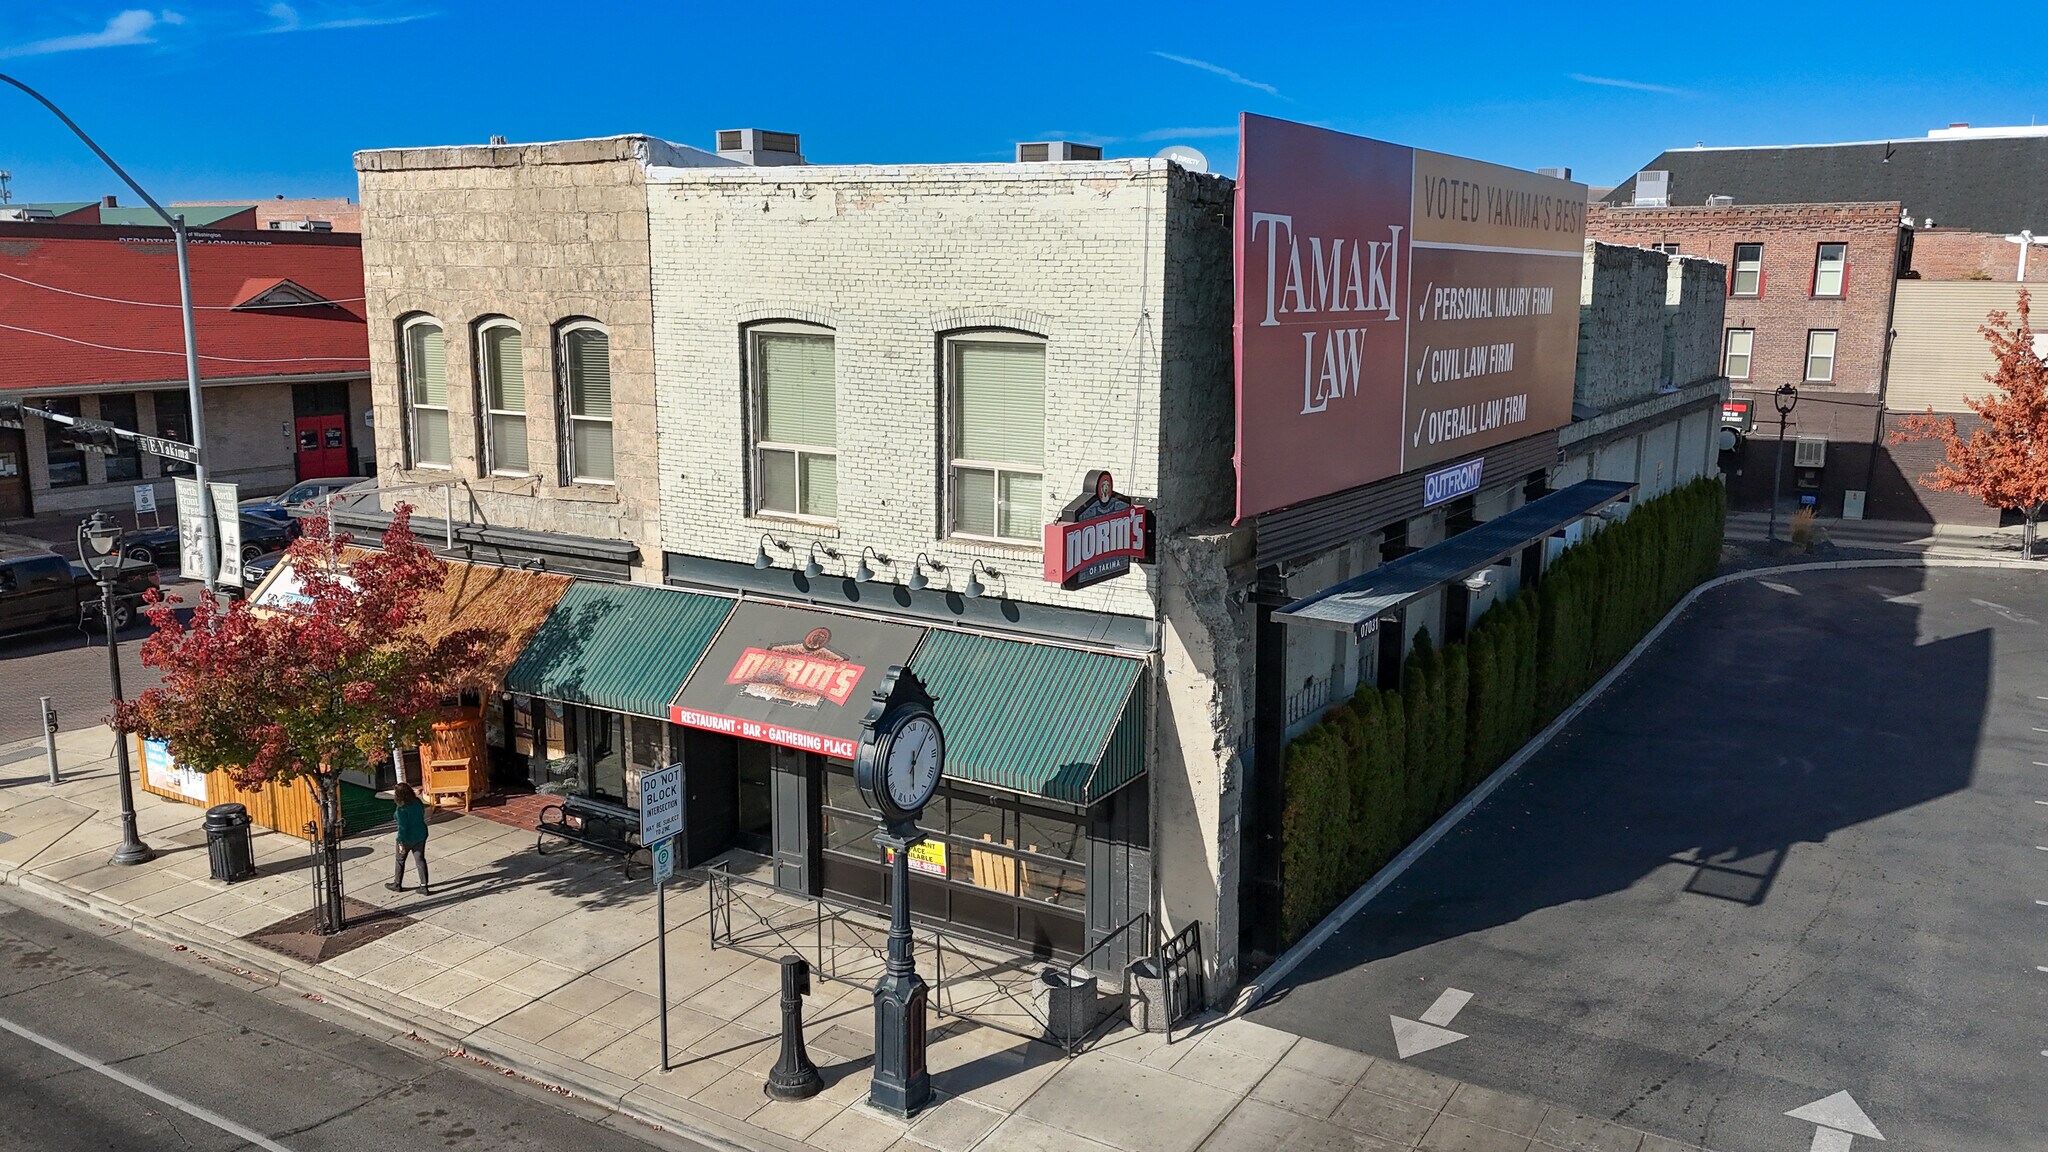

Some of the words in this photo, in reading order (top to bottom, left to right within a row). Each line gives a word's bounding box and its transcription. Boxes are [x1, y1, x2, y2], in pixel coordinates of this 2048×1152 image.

[1425, 175, 1479, 222] VOTED
[1487, 185, 1551, 231] YAKIMA'S
[1555, 198, 1584, 234] BEST
[1252, 211, 1404, 326] TAMAKI
[1434, 287, 1493, 321] PERSONAL
[1495, 287, 1532, 317] INJURY
[1532, 287, 1553, 315] FIRM
[1300, 328, 1367, 415] LAW
[1431, 348, 1460, 383] CIVIL
[1463, 345, 1488, 379] LAW
[1489, 342, 1514, 374] FIRM
[1428, 404, 1477, 445] OVERALL
[1480, 398, 1503, 432] LAW
[1503, 393, 1527, 426] FIRM
[149, 439, 158, 452] E
[158, 440, 189, 459] Yakima
[178, 485, 198, 496] North
[1427, 462, 1481, 501] OUTFRONT
[213, 489, 233, 501] North
[216, 500, 235, 511] Front
[180, 505, 199, 515] Stree
[218, 509, 237, 521] Street
[1089, 564, 1097, 575] OF
[1099, 560, 1121, 572] YAKIMA
[681, 710, 735, 733] RESTAURANT
[743, 722, 761, 738] BAR
[768, 727, 821, 750] GATHERING
[823, 739, 853, 757] PLACE
[644, 779, 657, 792] DO
[661, 769, 679, 786] NOT
[646, 784, 677, 805] BLOCK
[646, 798, 678, 818] INTERSECTION
[662, 814, 680, 826] SUBJECT
